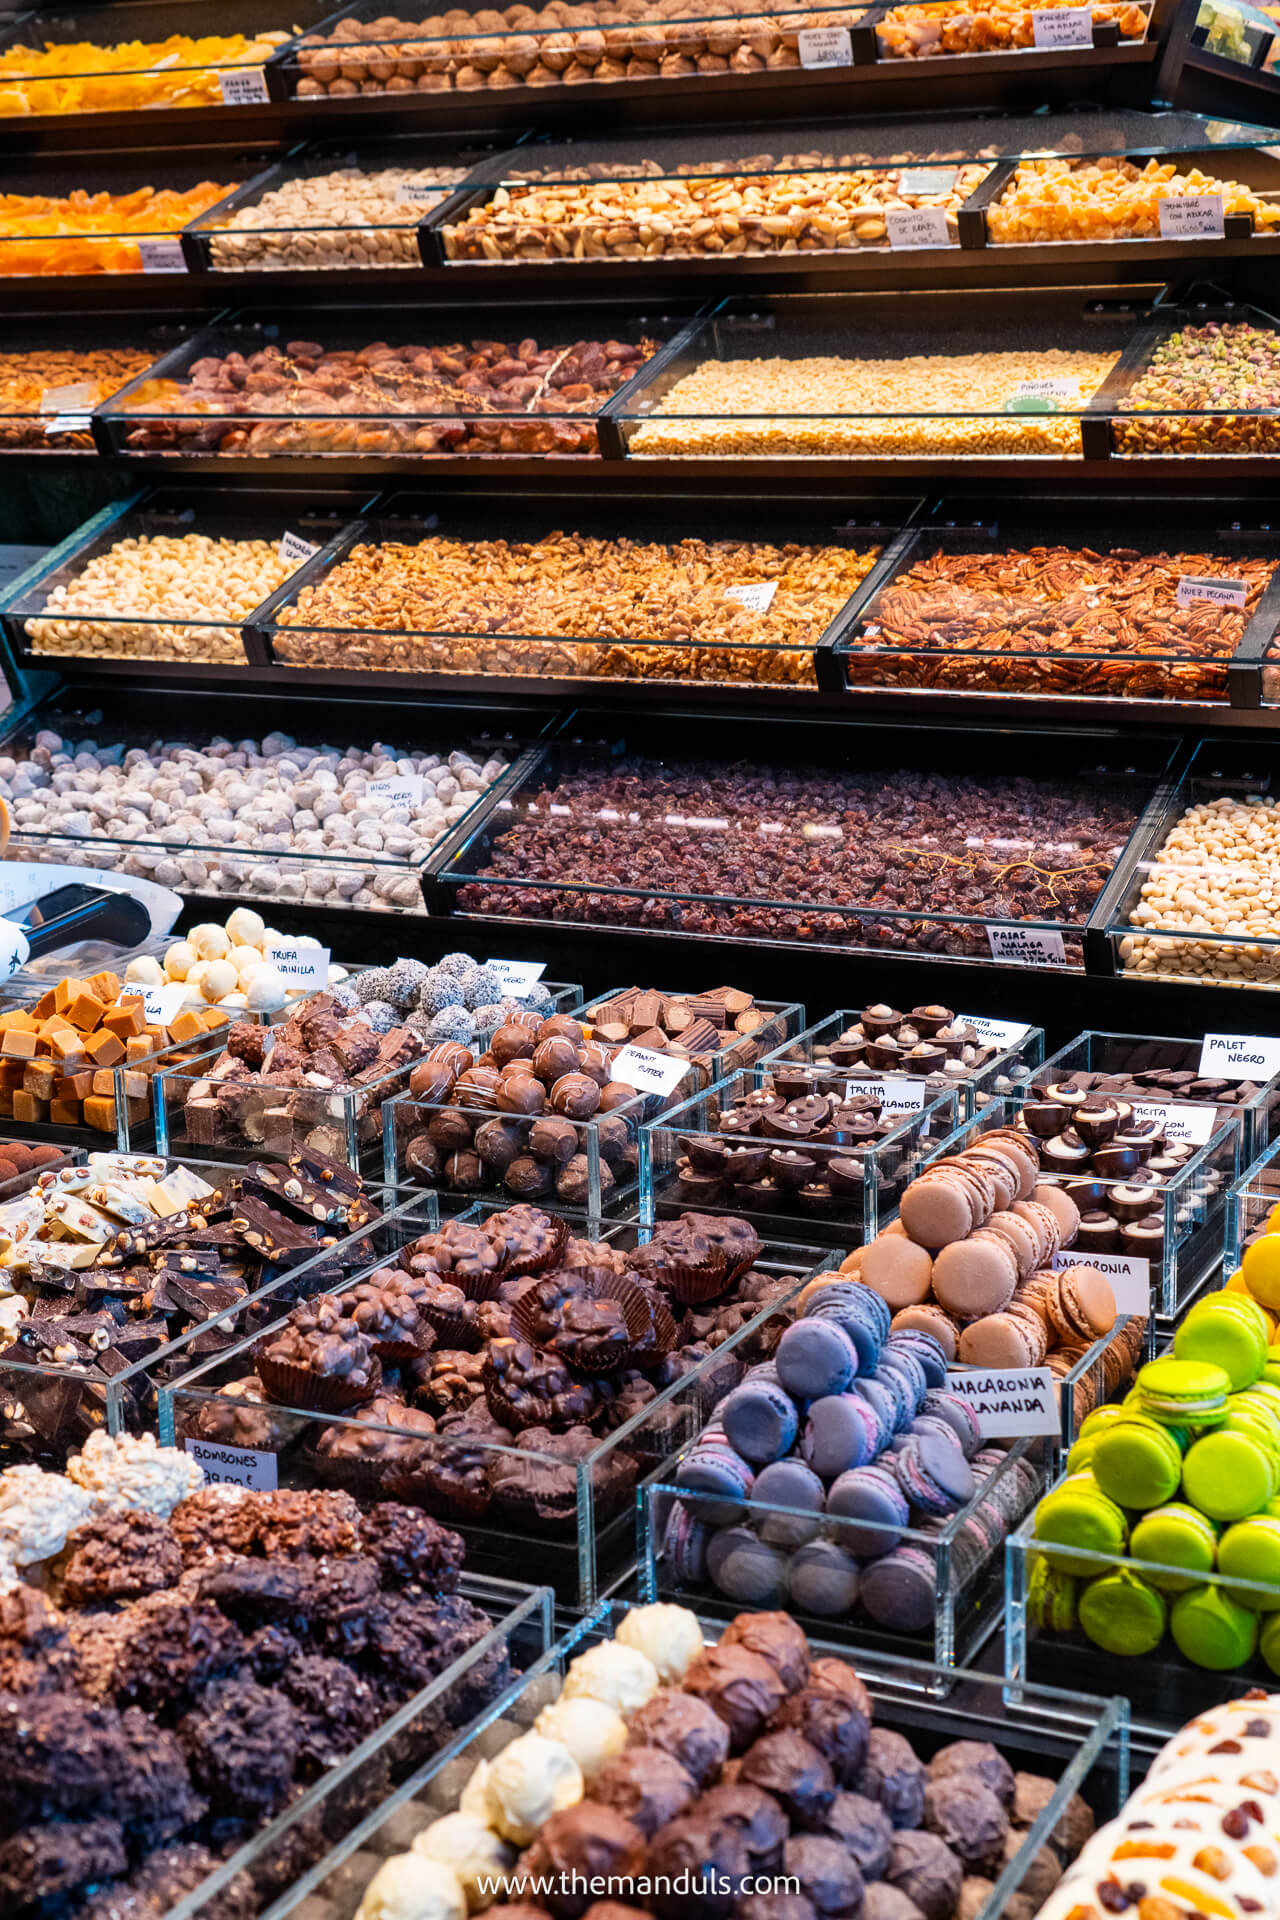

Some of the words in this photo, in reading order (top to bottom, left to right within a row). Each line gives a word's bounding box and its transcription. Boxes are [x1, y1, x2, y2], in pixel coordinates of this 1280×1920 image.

[993, 931, 1026, 940] PASAS
[272, 951, 297, 960] TRUFA
[277, 965, 315, 975] VAINILLA
[961, 1017, 991, 1027] TACITA
[1210, 1040, 1246, 1050] PALET
[1228, 1053, 1265, 1064] NEGRO
[850, 1085, 885, 1096] TACITA
[881, 1100, 921, 1109] RLANDES
[1134, 1107, 1167, 1117] ACITA
[1166, 1130, 1192, 1138] ECHE
[952, 1377, 1046, 1394] MACARONIA
[971, 1398, 1045, 1414] LAVANDA
[194, 1446, 257, 1467] BOMBONES
